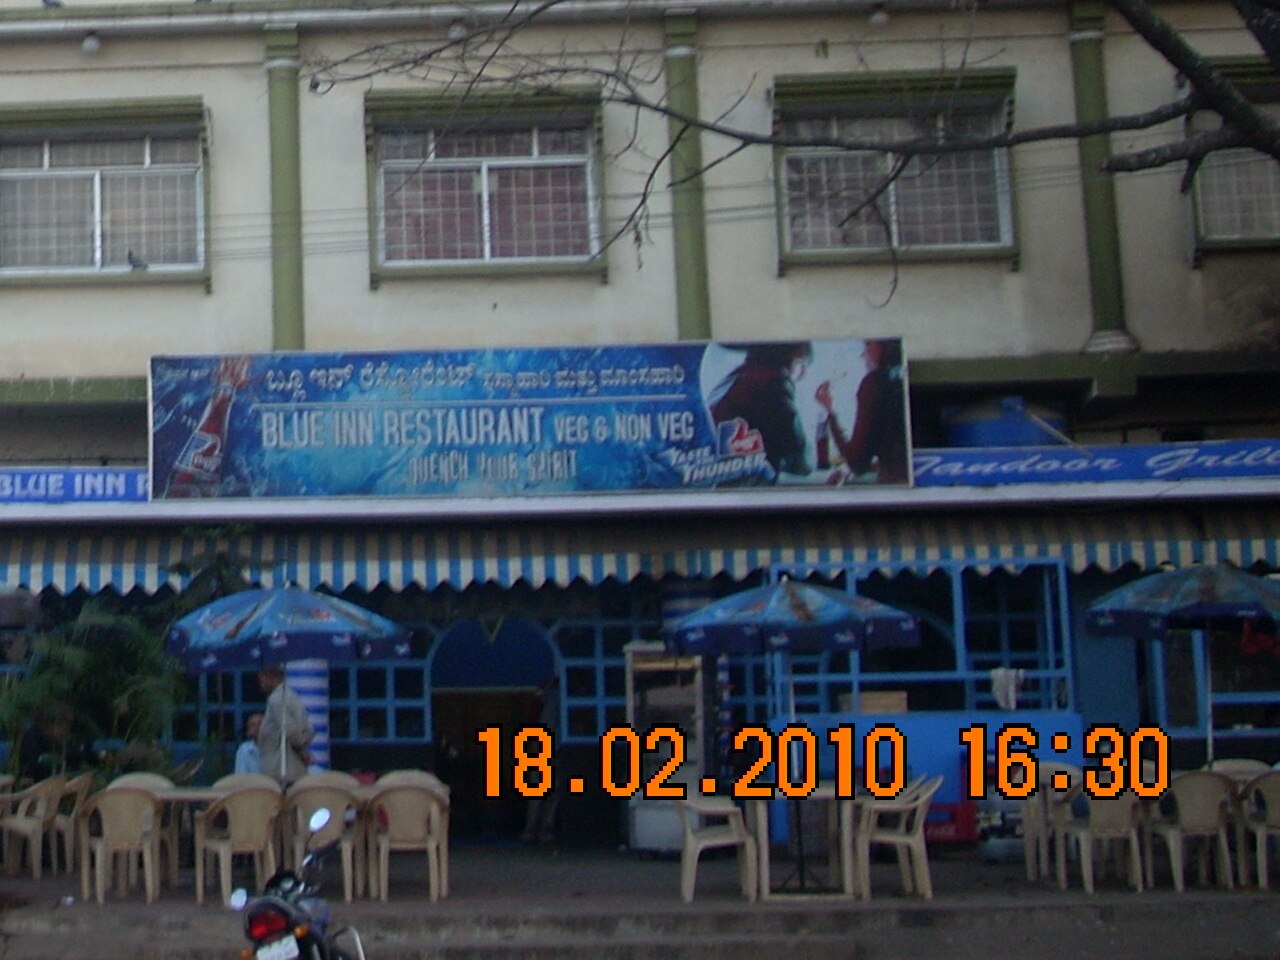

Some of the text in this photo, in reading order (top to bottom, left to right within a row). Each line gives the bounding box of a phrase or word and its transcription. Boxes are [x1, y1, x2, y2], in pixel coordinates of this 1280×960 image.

[261, 405, 695, 448] BLUE INN RESTAURANT VEG & NON VEG
[913, 453, 1122, 478] Tandoor
[74, 472, 126, 497] INN
